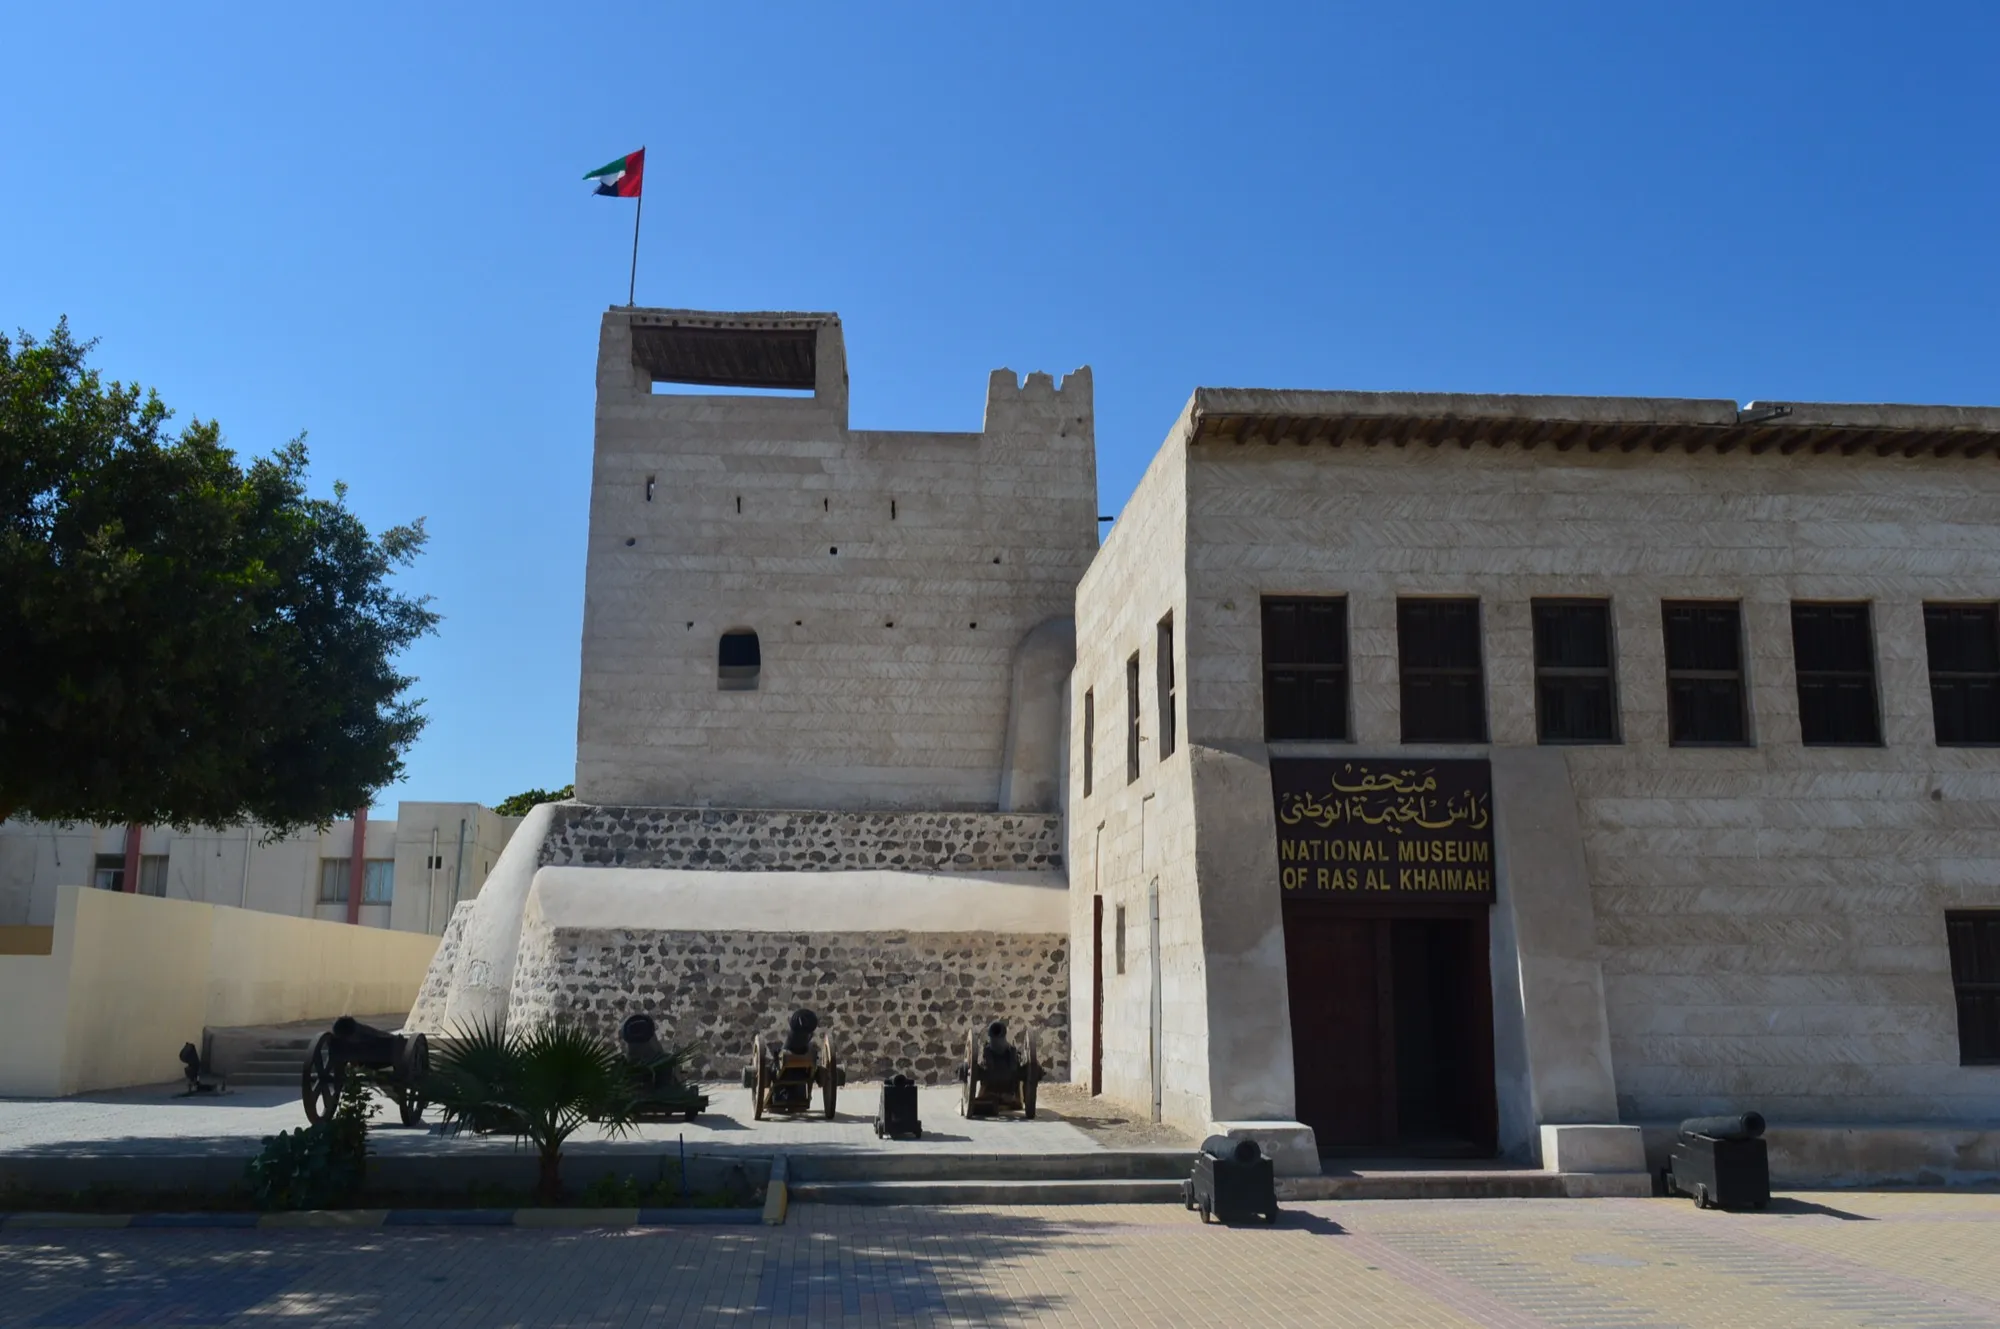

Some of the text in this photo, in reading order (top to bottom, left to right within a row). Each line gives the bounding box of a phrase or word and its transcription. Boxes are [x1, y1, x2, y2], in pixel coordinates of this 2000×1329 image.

[1281, 840, 1489, 862] NATIONAL MUSEUM
[1282, 867, 1490, 891] OF RAS AL KHAIMAH
